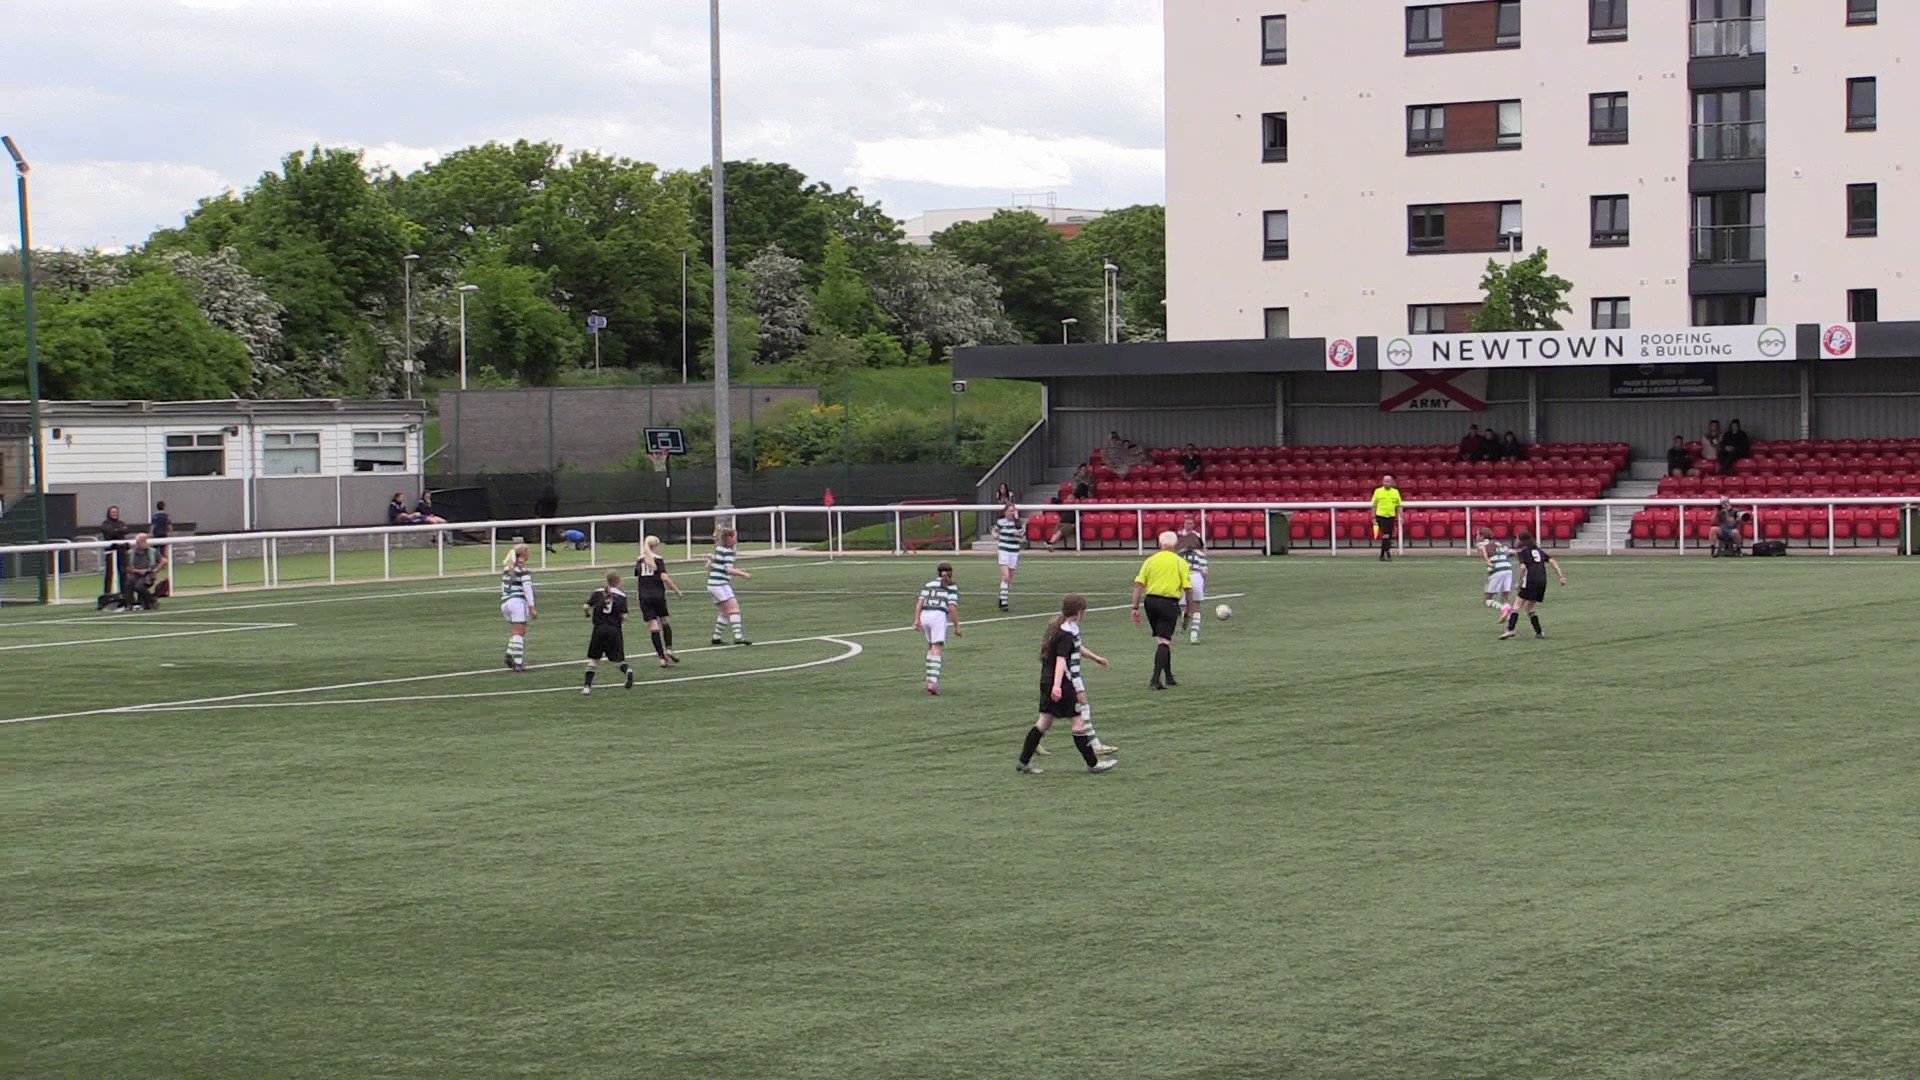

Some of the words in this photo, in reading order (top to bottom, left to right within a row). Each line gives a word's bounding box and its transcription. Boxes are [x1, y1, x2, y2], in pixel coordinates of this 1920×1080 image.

[1640, 333, 1713, 345] ROOFING
[1432, 335, 1624, 361] NEWTOWN
[1640, 346, 1650, 357] &
[1656, 344, 1732, 356] BUILDING
[1409, 399, 1451, 409] ARMY
[1530, 549, 1542, 563] 9
[602, 598, 613, 614] 3
